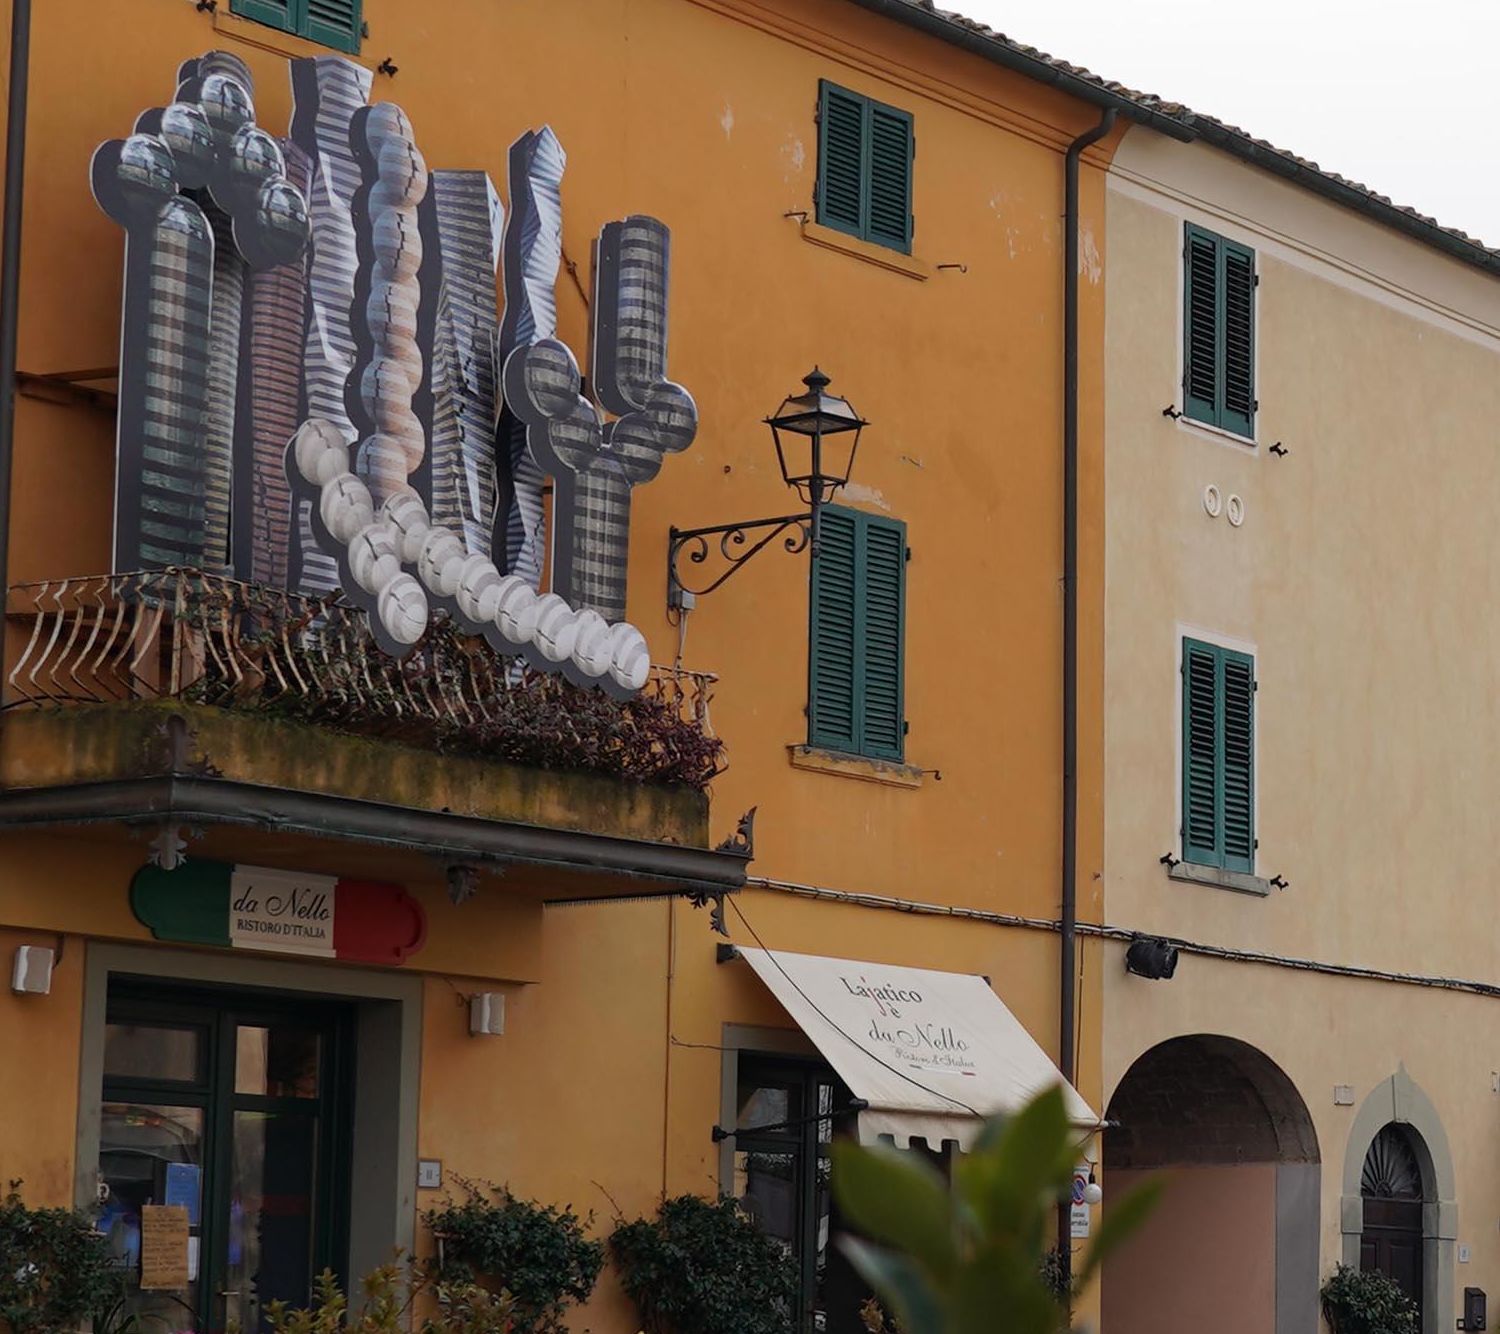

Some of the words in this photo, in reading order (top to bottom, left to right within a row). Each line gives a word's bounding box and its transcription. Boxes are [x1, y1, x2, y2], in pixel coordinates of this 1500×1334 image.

[233, 886, 258, 913] da
[266, 887, 330, 921] Nello
[237, 919, 281, 934] RISTORO
[283, 924, 325, 939] D'ITALIA
[839, 976, 922, 1016] Lajatico
[869, 1019, 894, 1044] da
[897, 1023, 969, 1052] Nello
